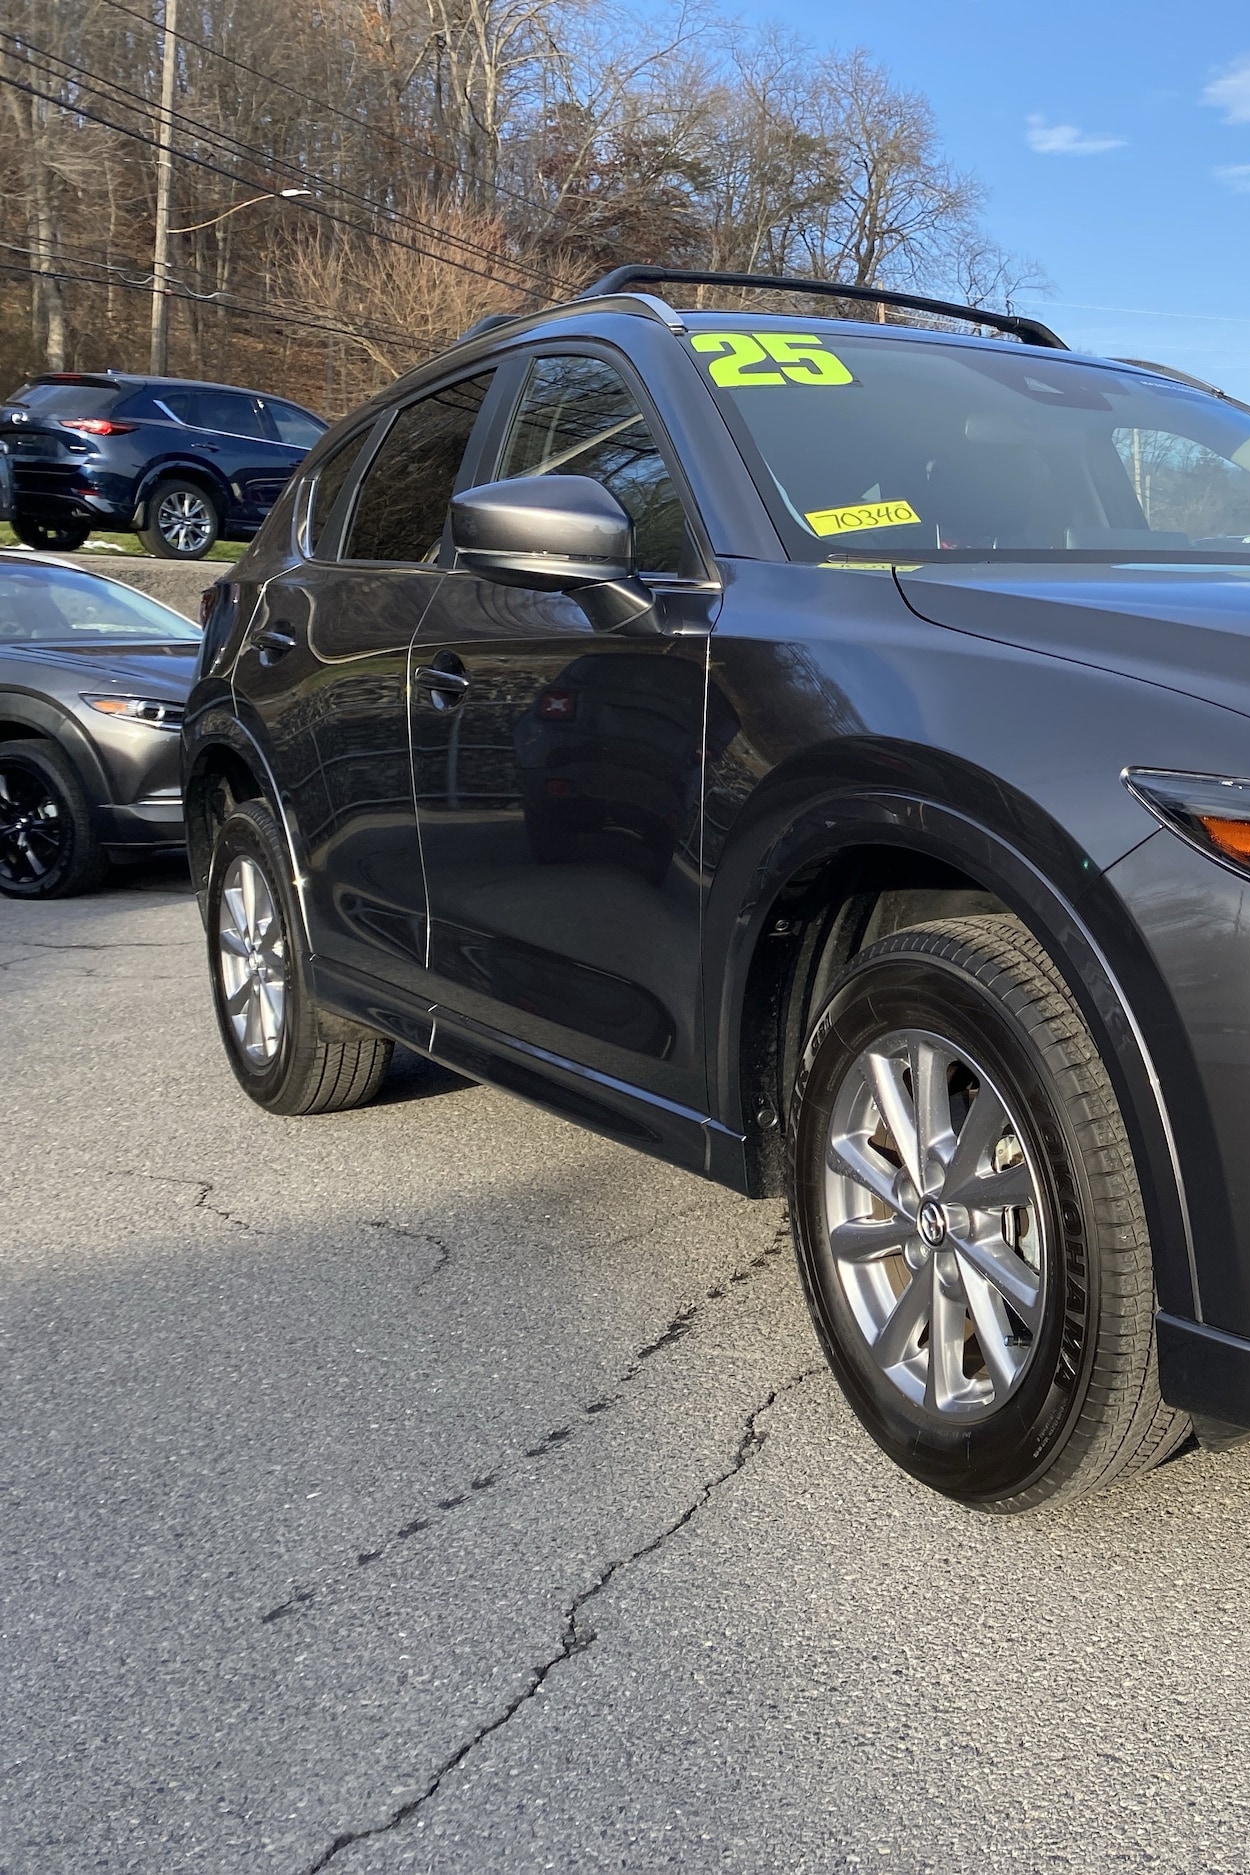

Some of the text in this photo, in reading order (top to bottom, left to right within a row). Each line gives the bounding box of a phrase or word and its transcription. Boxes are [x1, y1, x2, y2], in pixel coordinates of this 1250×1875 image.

[691, 333, 854, 387] 25
[815, 506, 913, 529] 70340
[1030, 1087, 1087, 1393] YOKOHAMA
